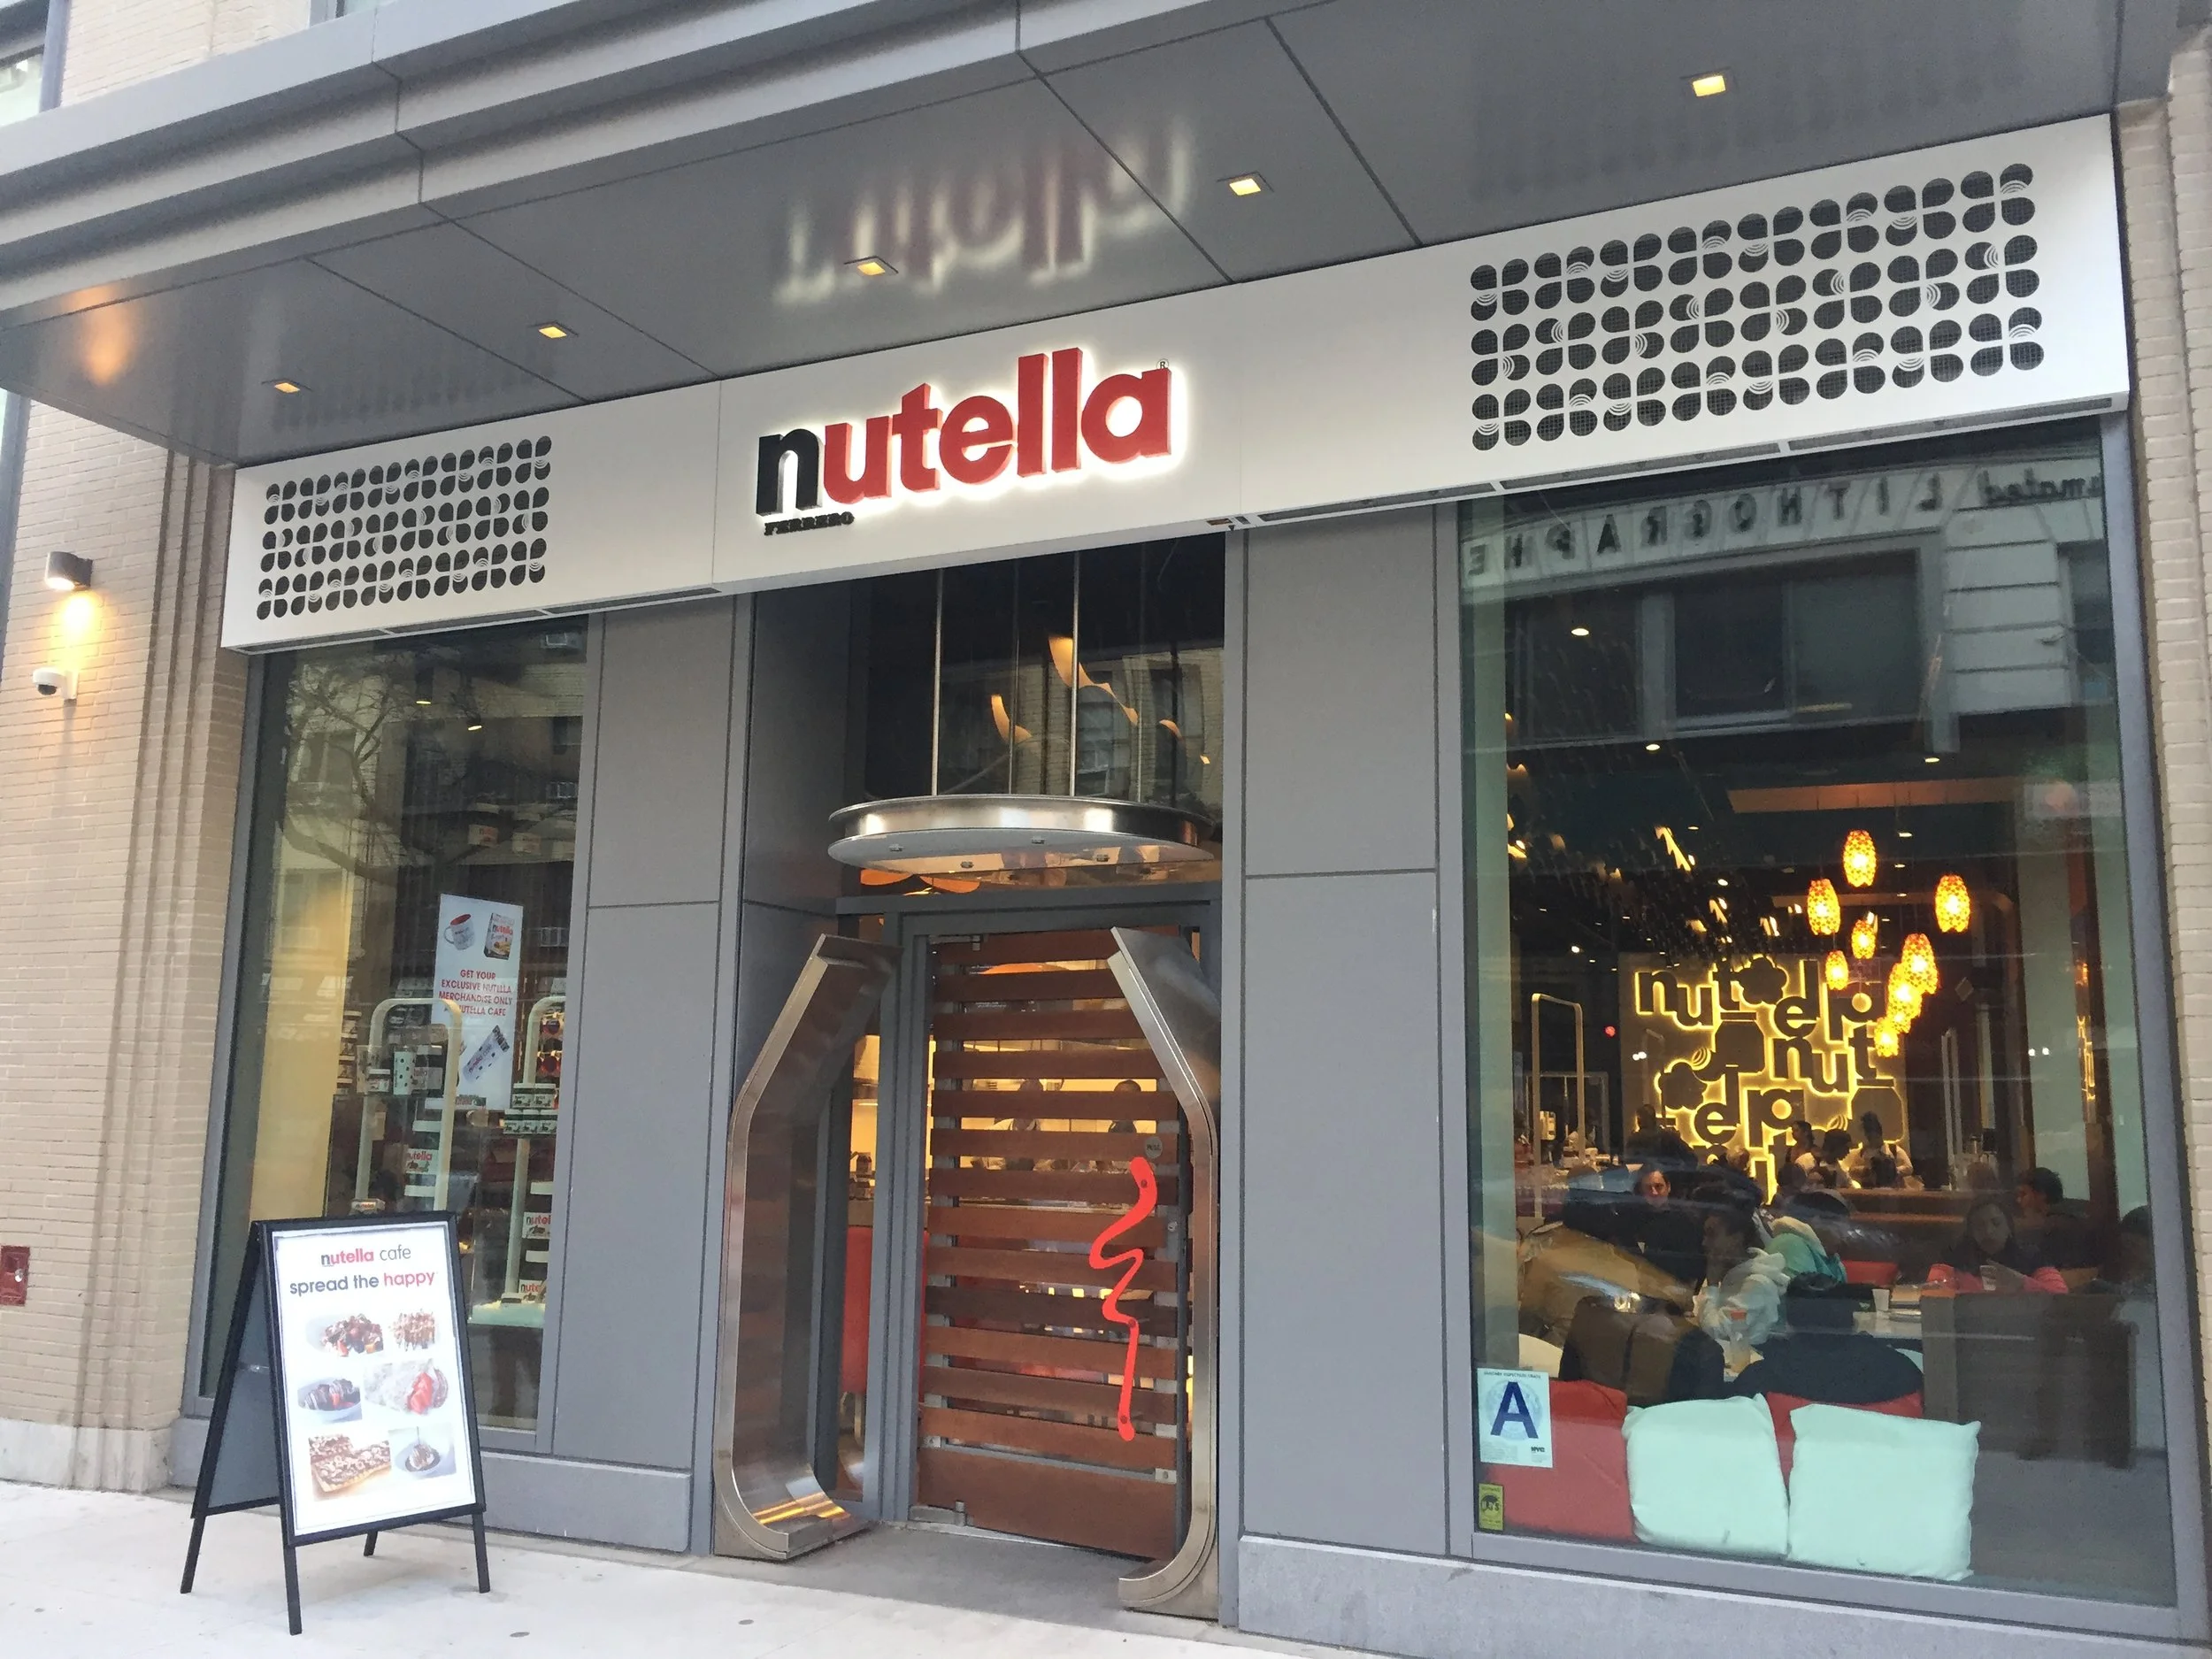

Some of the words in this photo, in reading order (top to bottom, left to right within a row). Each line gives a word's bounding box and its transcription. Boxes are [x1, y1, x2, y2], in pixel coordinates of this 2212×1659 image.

[756, 347, 1171, 517] nutella
[460, 969, 474, 979] GET
[476, 971, 496, 980] YOUR
[441, 979, 481, 991] EXCLUSIVE
[438, 990, 492, 1004] MERCHANDISE
[493, 995, 513, 1005] ONLY
[488, 1008, 506, 1017] CAFE
[320, 1248, 374, 1265] nutella
[380, 1244, 411, 1262] cafe
[289, 1276, 349, 1297] spread
[353, 1274, 380, 1289] the
[383, 1271, 435, 1288] happy
[1490, 1381, 1539, 1439] A
